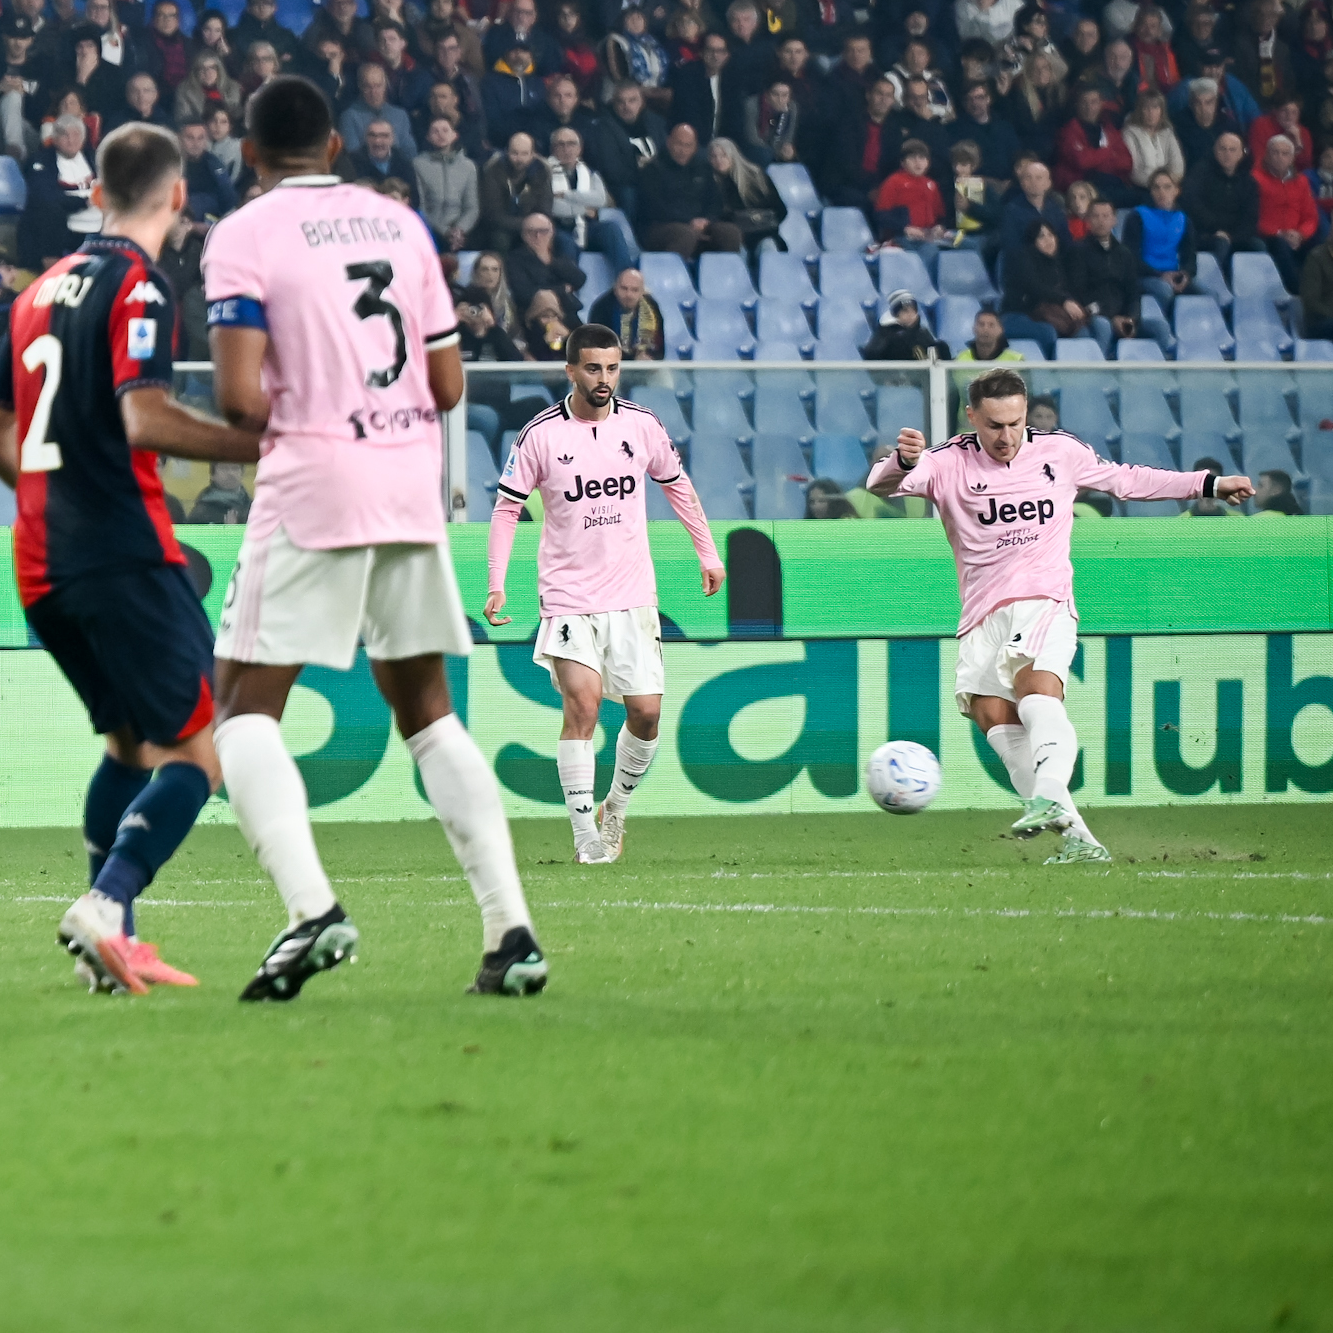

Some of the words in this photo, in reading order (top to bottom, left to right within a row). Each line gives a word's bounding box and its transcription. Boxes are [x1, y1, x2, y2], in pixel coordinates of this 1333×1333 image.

[300, 217, 404, 248] BREMER
[345, 259, 407, 389] 3
[21, 334, 63, 472] 2
[563, 474, 636, 502] Jeep
[583, 513, 622, 530] Detroit
[590, 504, 614, 515] VISIT
[978, 498, 1054, 525] Jeep
[996, 534, 1040, 550] Detroit
